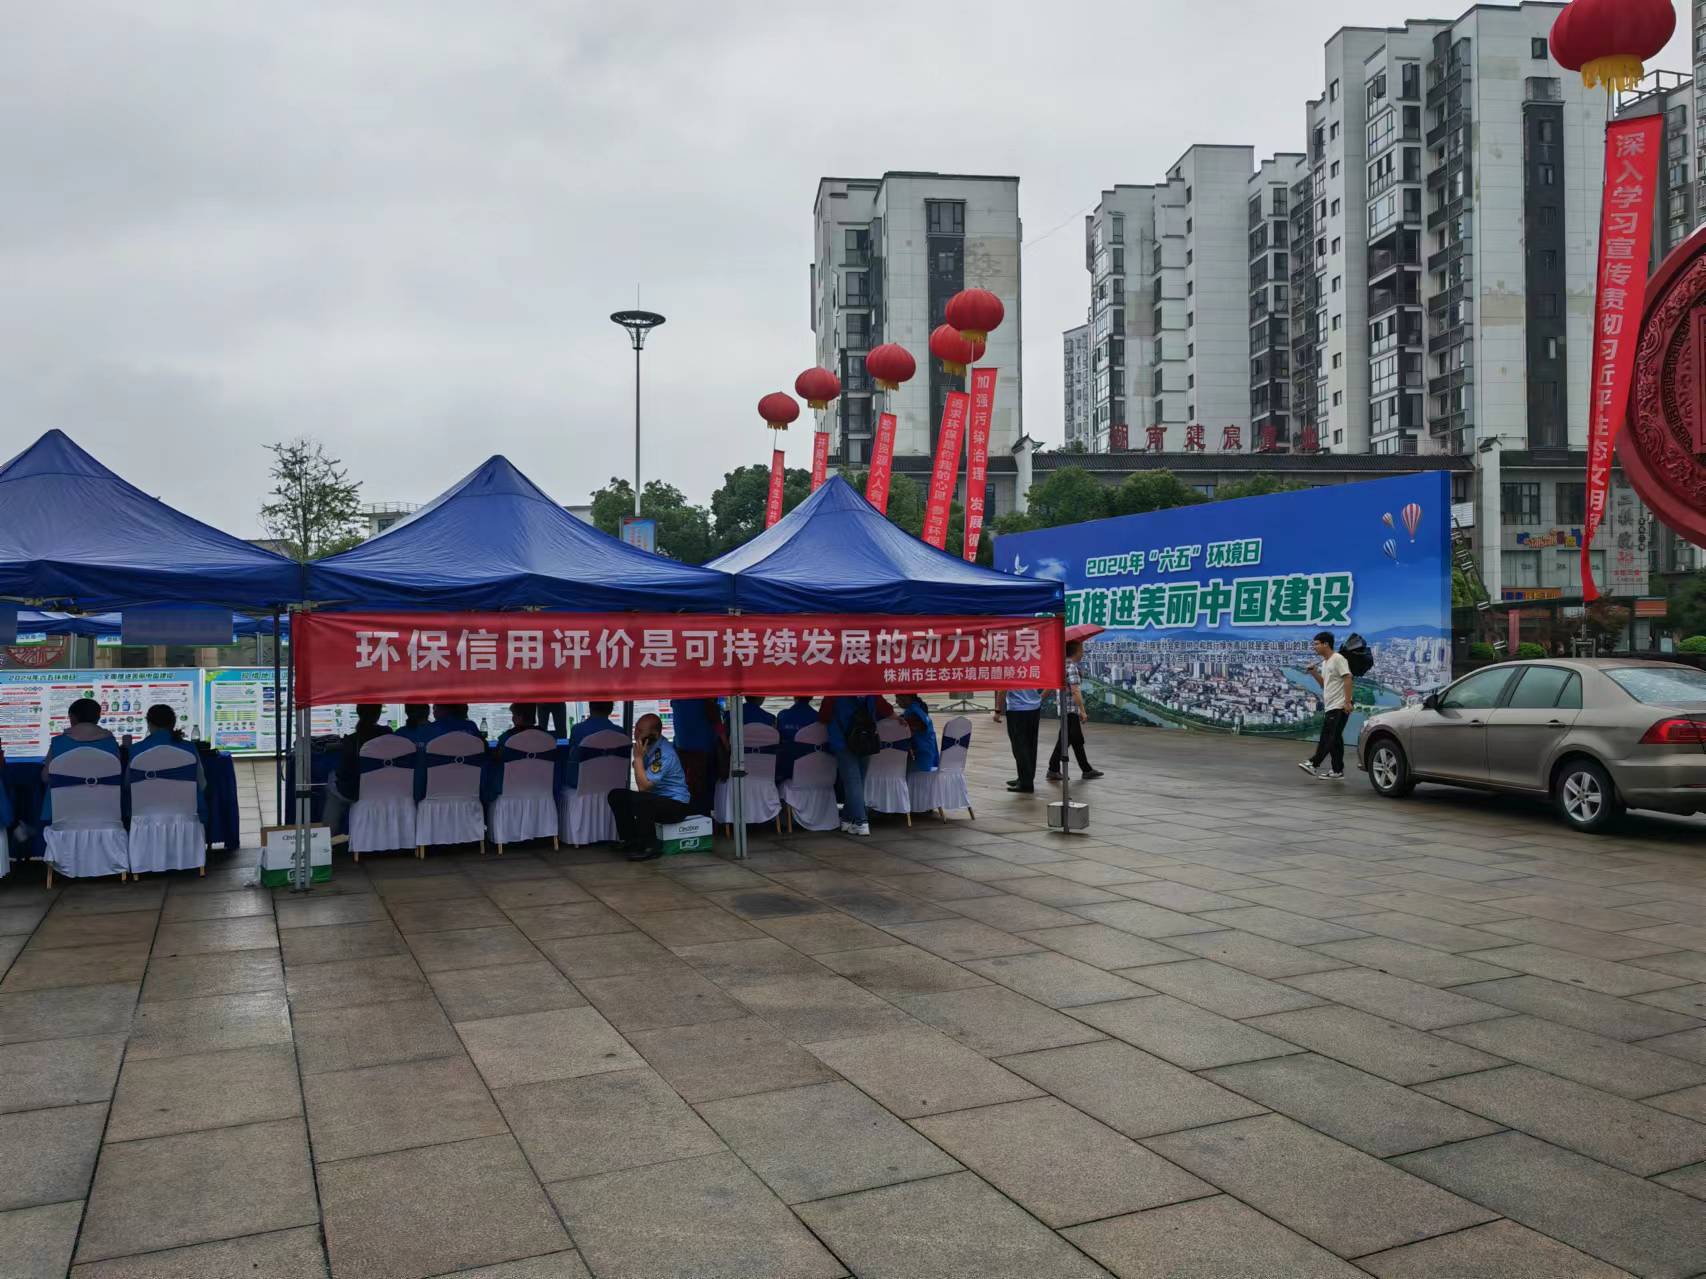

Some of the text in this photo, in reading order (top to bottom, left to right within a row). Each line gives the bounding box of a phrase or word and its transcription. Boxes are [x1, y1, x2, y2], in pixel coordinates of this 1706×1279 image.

[972, 375, 990, 481] 加强污染治理
[1064, 572, 1353, 628] 面推进美丽中国建设
[355, 627, 1042, 672] 环保信用评价是可持续发展的动力源泉
[884, 665, 1041, 682] 株洲市生态环境局醴陵分局
